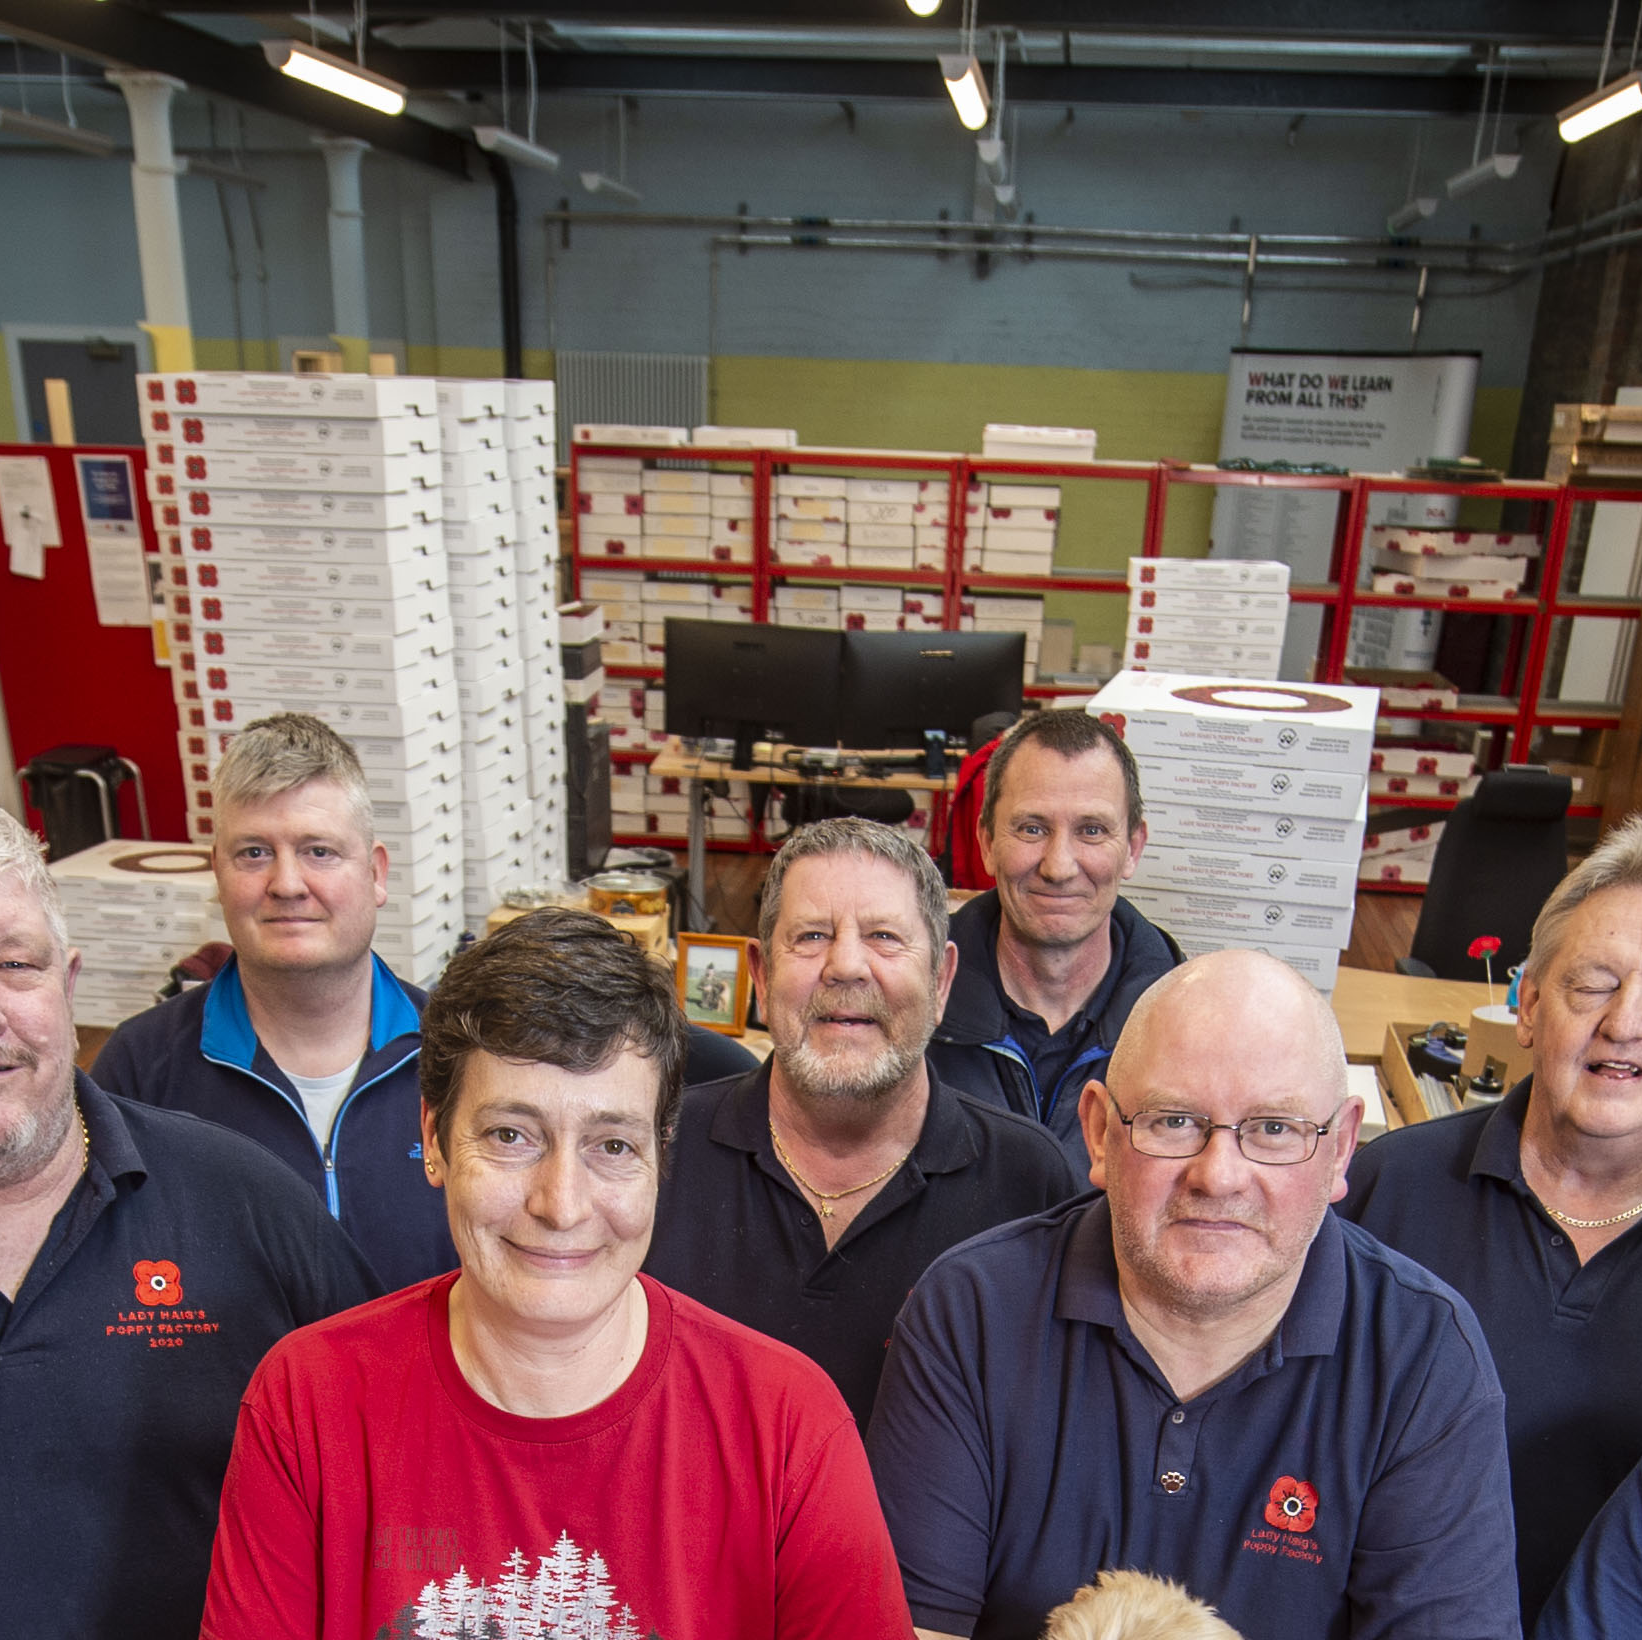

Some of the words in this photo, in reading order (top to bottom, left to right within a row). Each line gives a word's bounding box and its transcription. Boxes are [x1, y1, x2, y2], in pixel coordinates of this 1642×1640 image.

[1248, 372, 1295, 388] WHAT
[1299, 374, 1323, 389] DO
[1328, 375, 1349, 390] WE
[1352, 376, 1392, 392] LEARN
[1246, 390, 1293, 406] FROM
[1296, 392, 1323, 407] ALL
[118, 1311, 155, 1322] LADY
[161, 1309, 205, 1320] HAIG'S
[106, 1325, 153, 1336] POPPY
[157, 1323, 219, 1334] FACTORY
[149, 1337, 183, 1348] 2020
[1251, 1528, 1280, 1542] Lady
[1283, 1533, 1318, 1550] Haig's
[1242, 1540, 1277, 1555] Poppy
[1282, 1544, 1323, 1565] Factory
